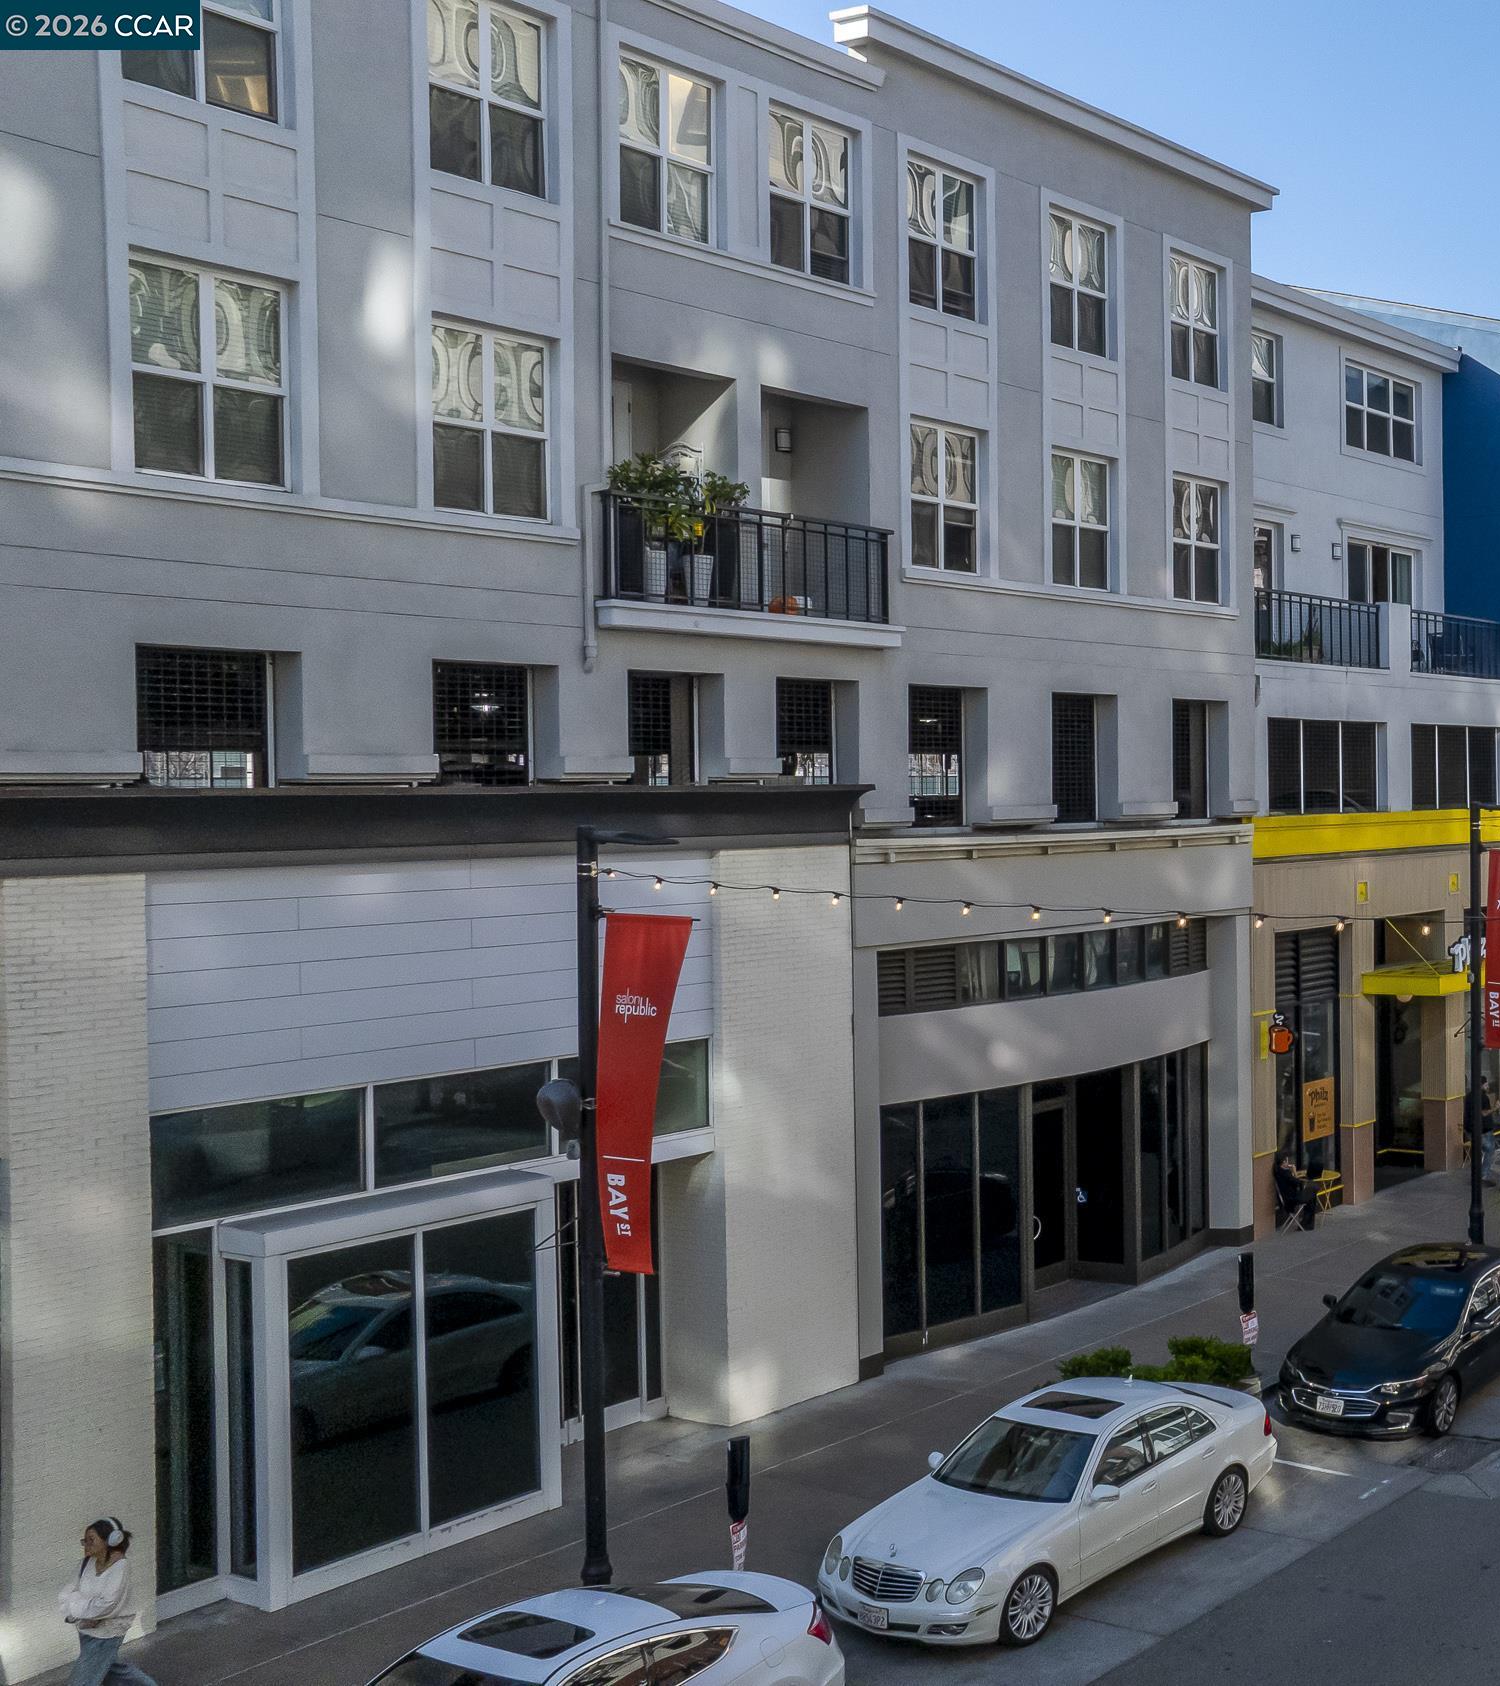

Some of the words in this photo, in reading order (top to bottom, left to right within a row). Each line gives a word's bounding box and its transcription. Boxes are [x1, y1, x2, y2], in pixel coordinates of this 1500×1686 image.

[615, 987, 640, 1005] salon
[1489, 991, 1500, 1019] BAY
[615, 997, 657, 1024] republic
[606, 1173, 630, 1221] BAY
[617, 1222, 632, 1237] ST
